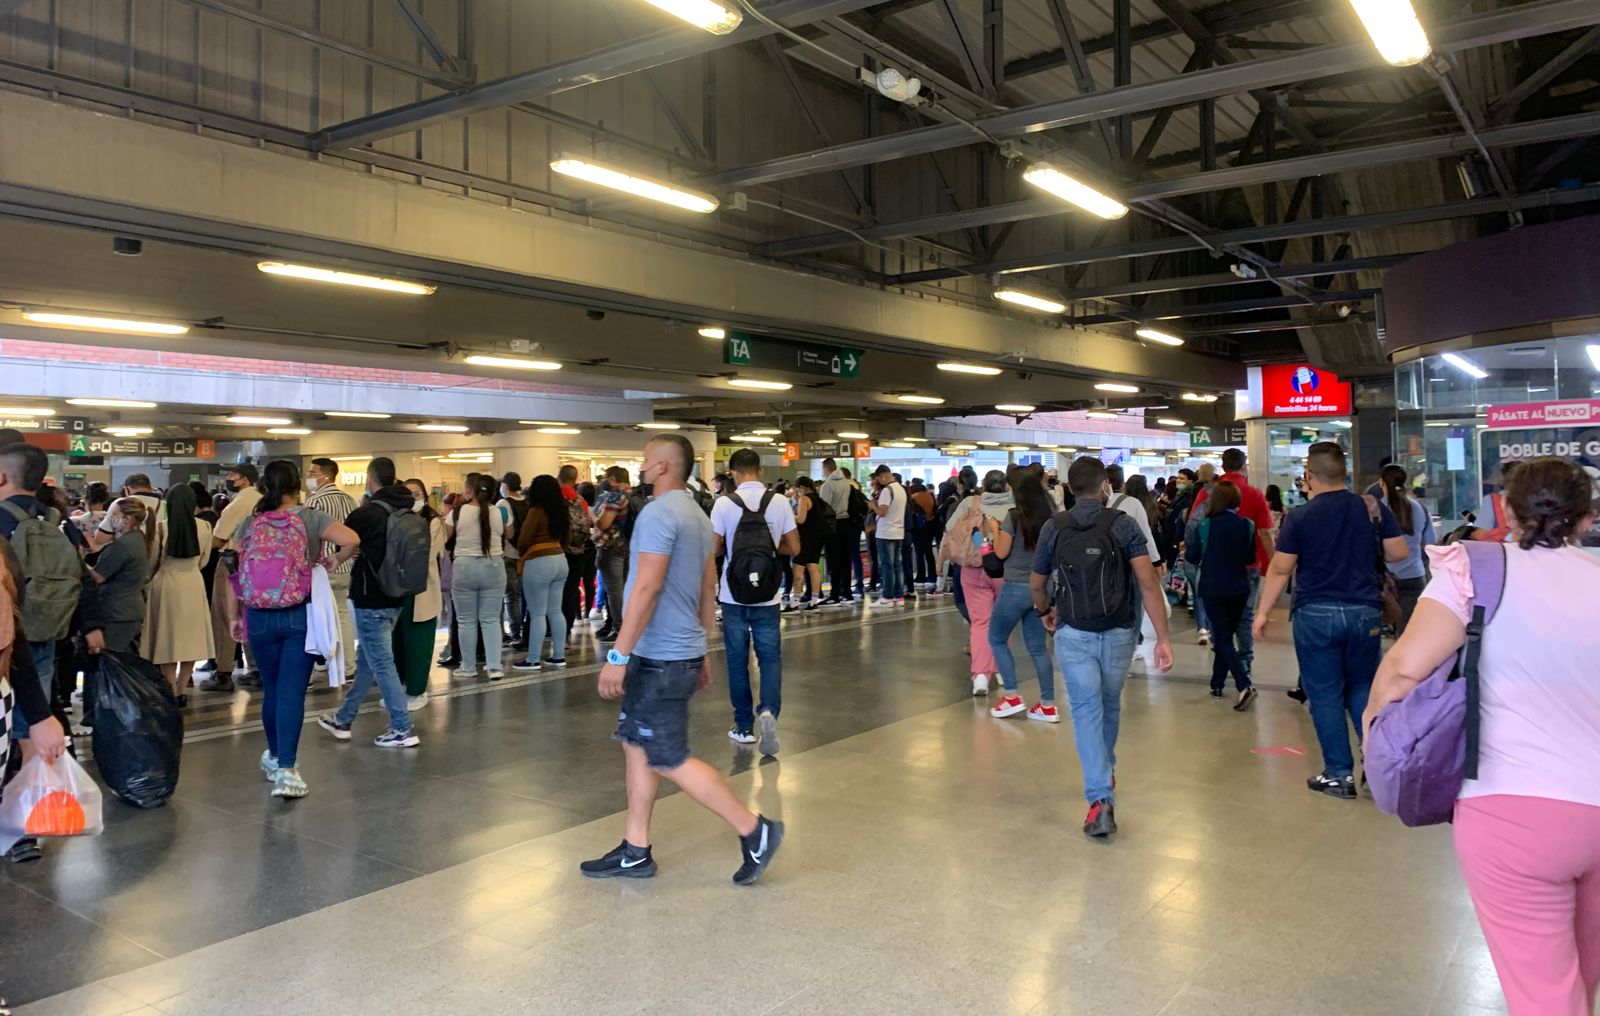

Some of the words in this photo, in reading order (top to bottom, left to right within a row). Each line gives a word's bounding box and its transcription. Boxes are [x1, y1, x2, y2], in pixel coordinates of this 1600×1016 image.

[1274, 405, 1308, 413] Domicilios
[1492, 409, 1529, 421] PÁSATE
[1531, 410, 1545, 419] AL
[1547, 407, 1587, 418] NUEVO
[4, 419, 40, 429] Antonio
[202, 442, 209, 454] B
[788, 445, 796, 457] B
[1500, 442, 1553, 458] DOBLE
[1556, 442, 1582, 456] DE
